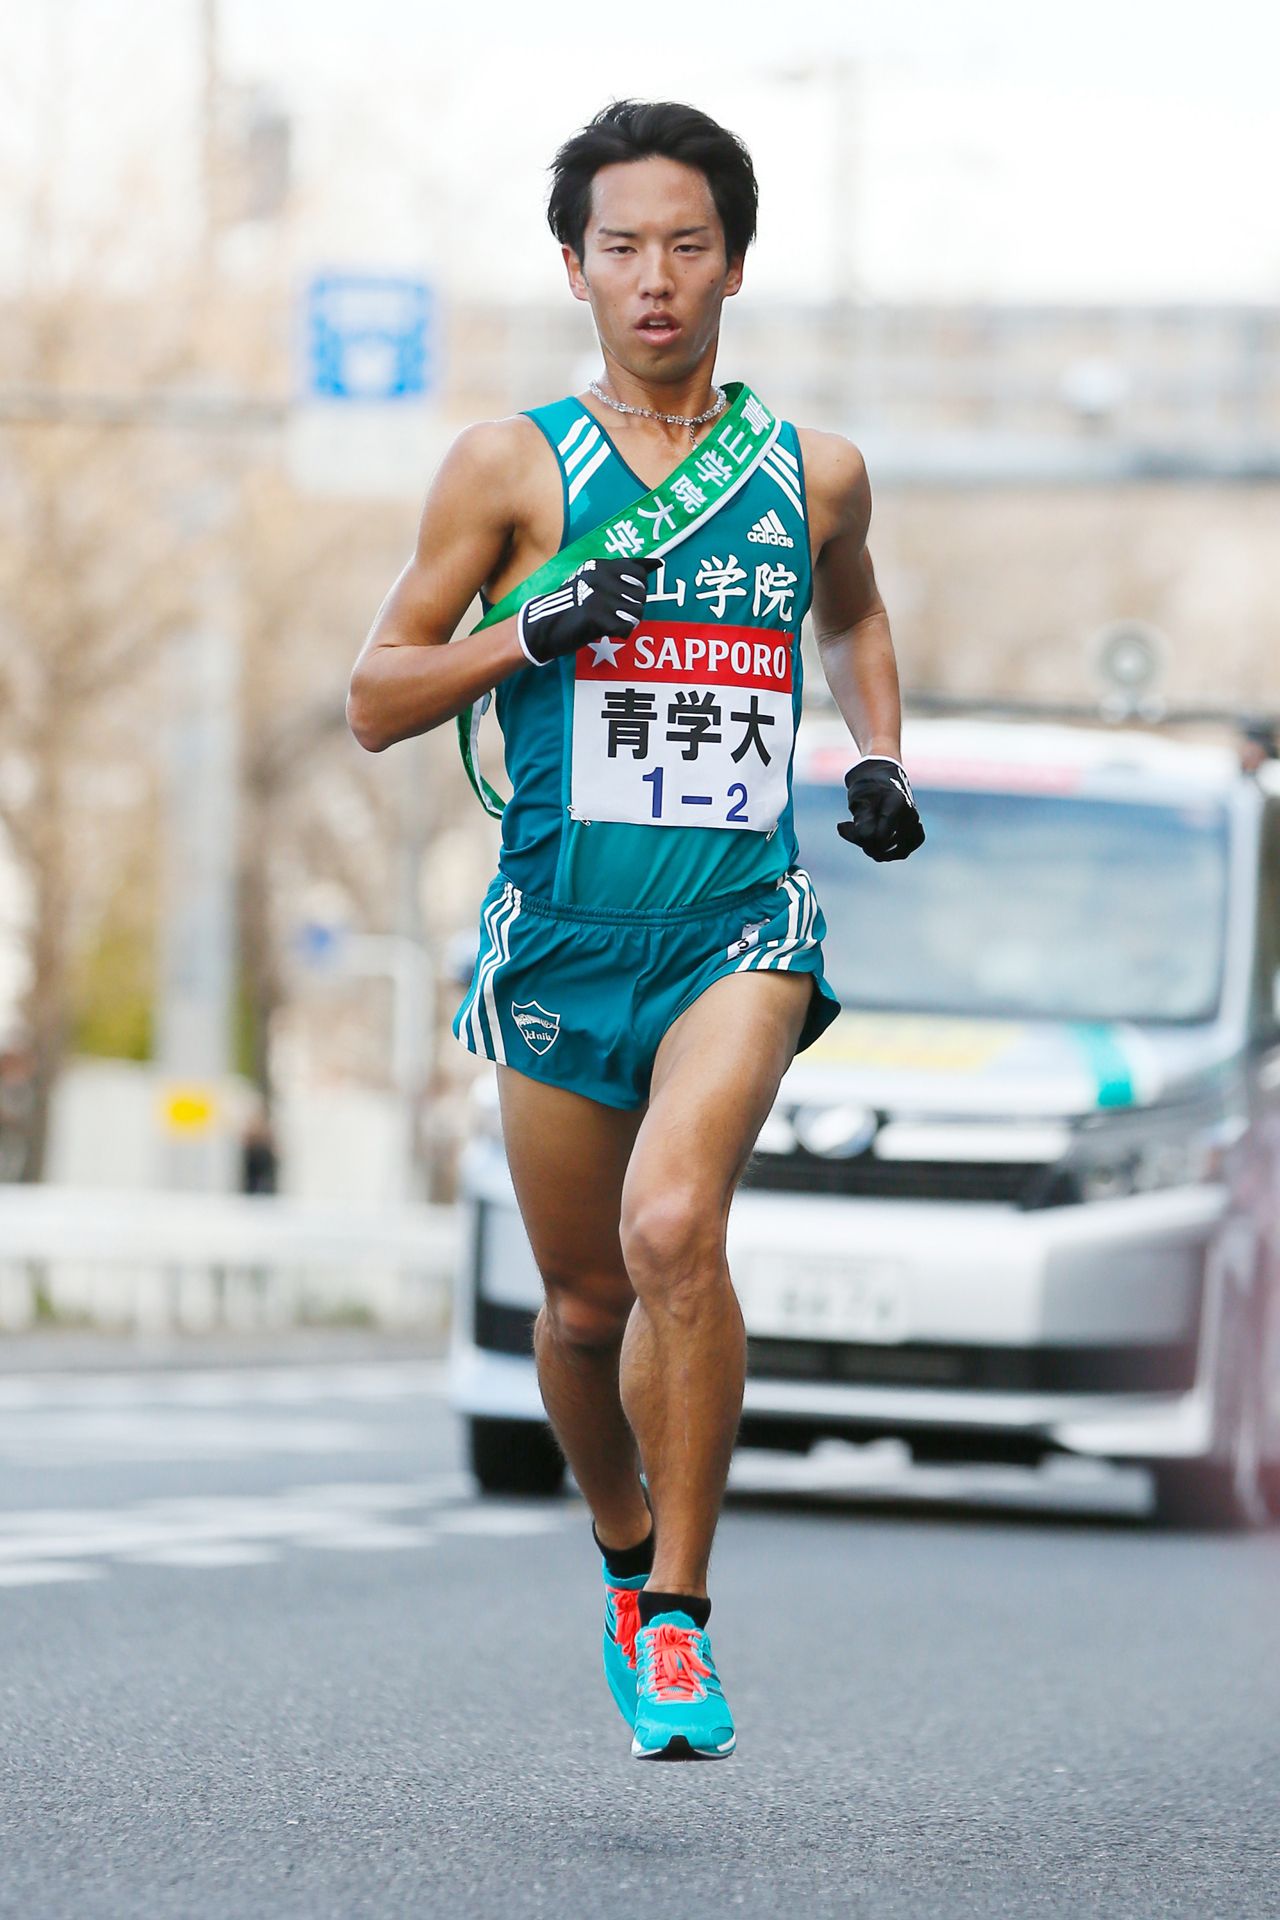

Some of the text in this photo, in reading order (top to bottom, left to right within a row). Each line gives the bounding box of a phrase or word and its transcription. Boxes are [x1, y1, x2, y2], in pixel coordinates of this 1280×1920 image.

[747, 531, 794, 548] adidas
[634, 635, 786, 679] SAPPORO
[601, 688, 775, 767] 青学大
